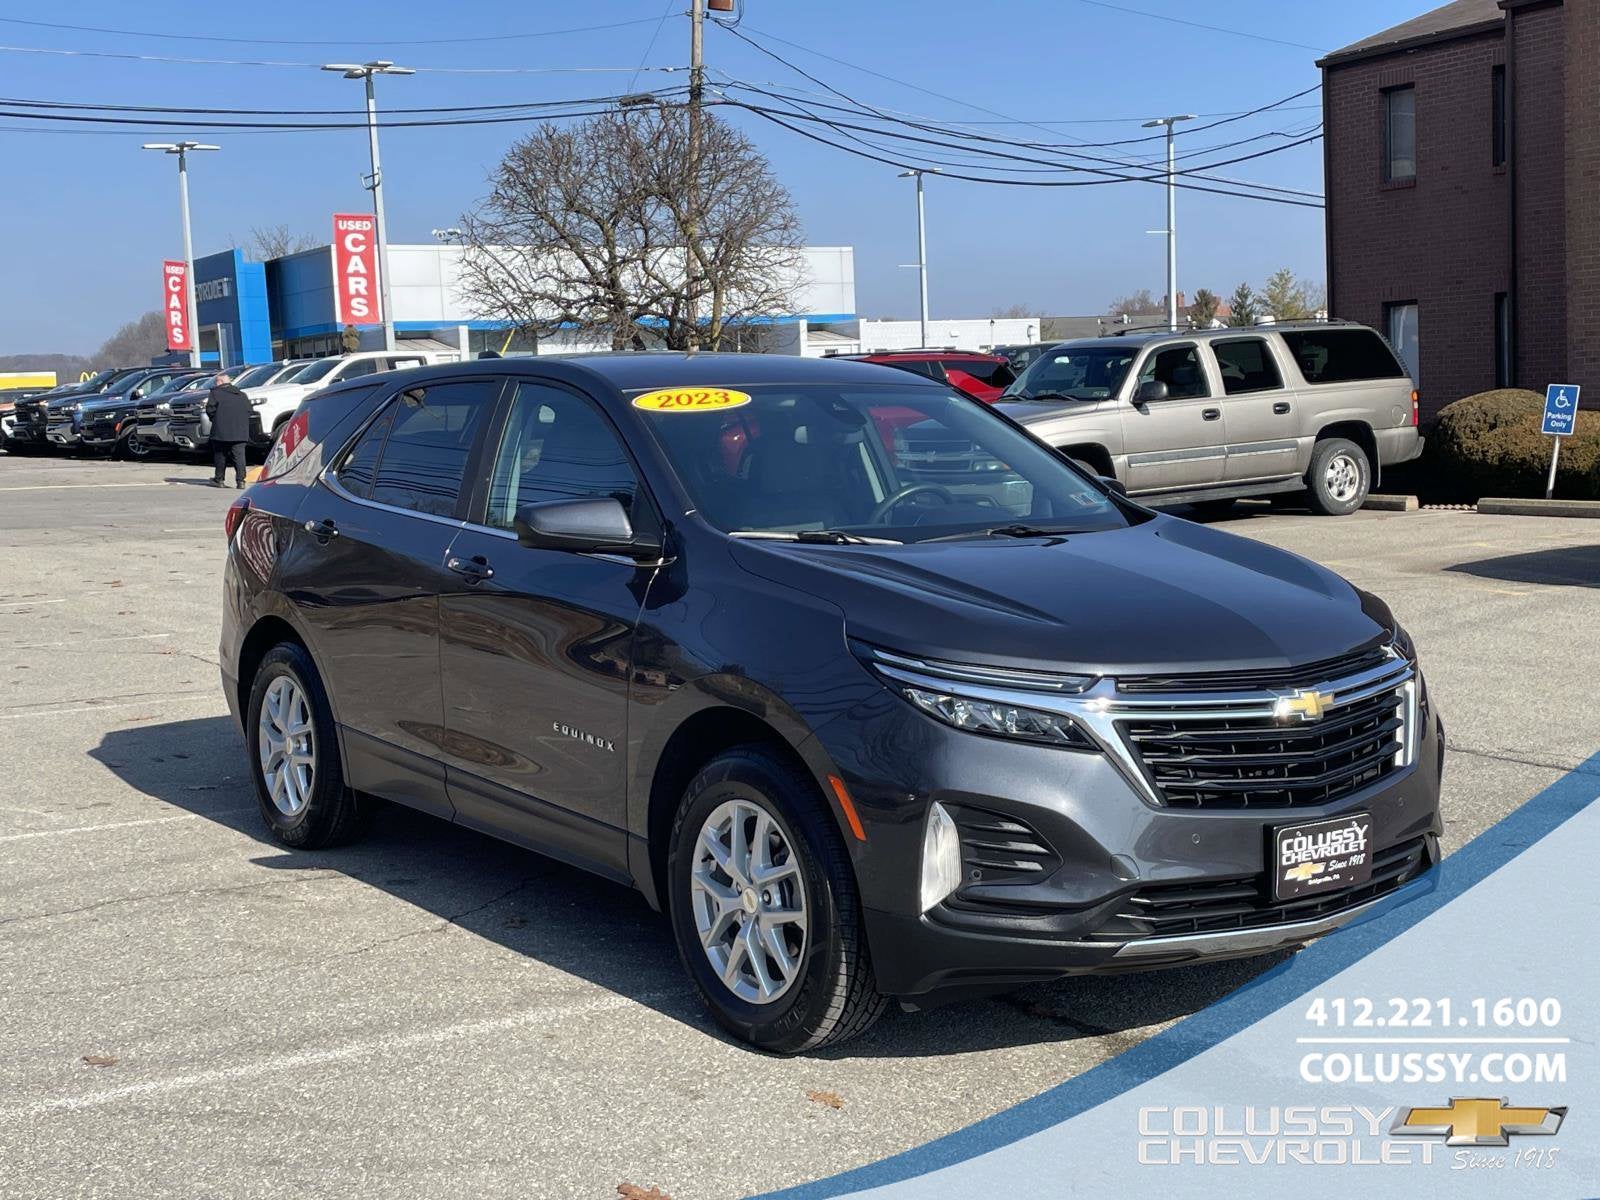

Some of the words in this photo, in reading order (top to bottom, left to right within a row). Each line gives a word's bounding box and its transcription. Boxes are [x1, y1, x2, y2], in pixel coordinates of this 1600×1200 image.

[338, 220, 372, 231] USED
[165, 265, 185, 275] USED
[344, 233, 370, 317] CARS
[168, 276, 184, 344] CARS
[657, 391, 731, 408] 2023
[1547, 412, 1572, 421] Parking
[1550, 420, 1567, 428] Only
[553, 721, 615, 752] EQUINOX
[1282, 825, 1368, 854] COLUSSY
[1282, 839, 1367, 865] CHEVROLET
